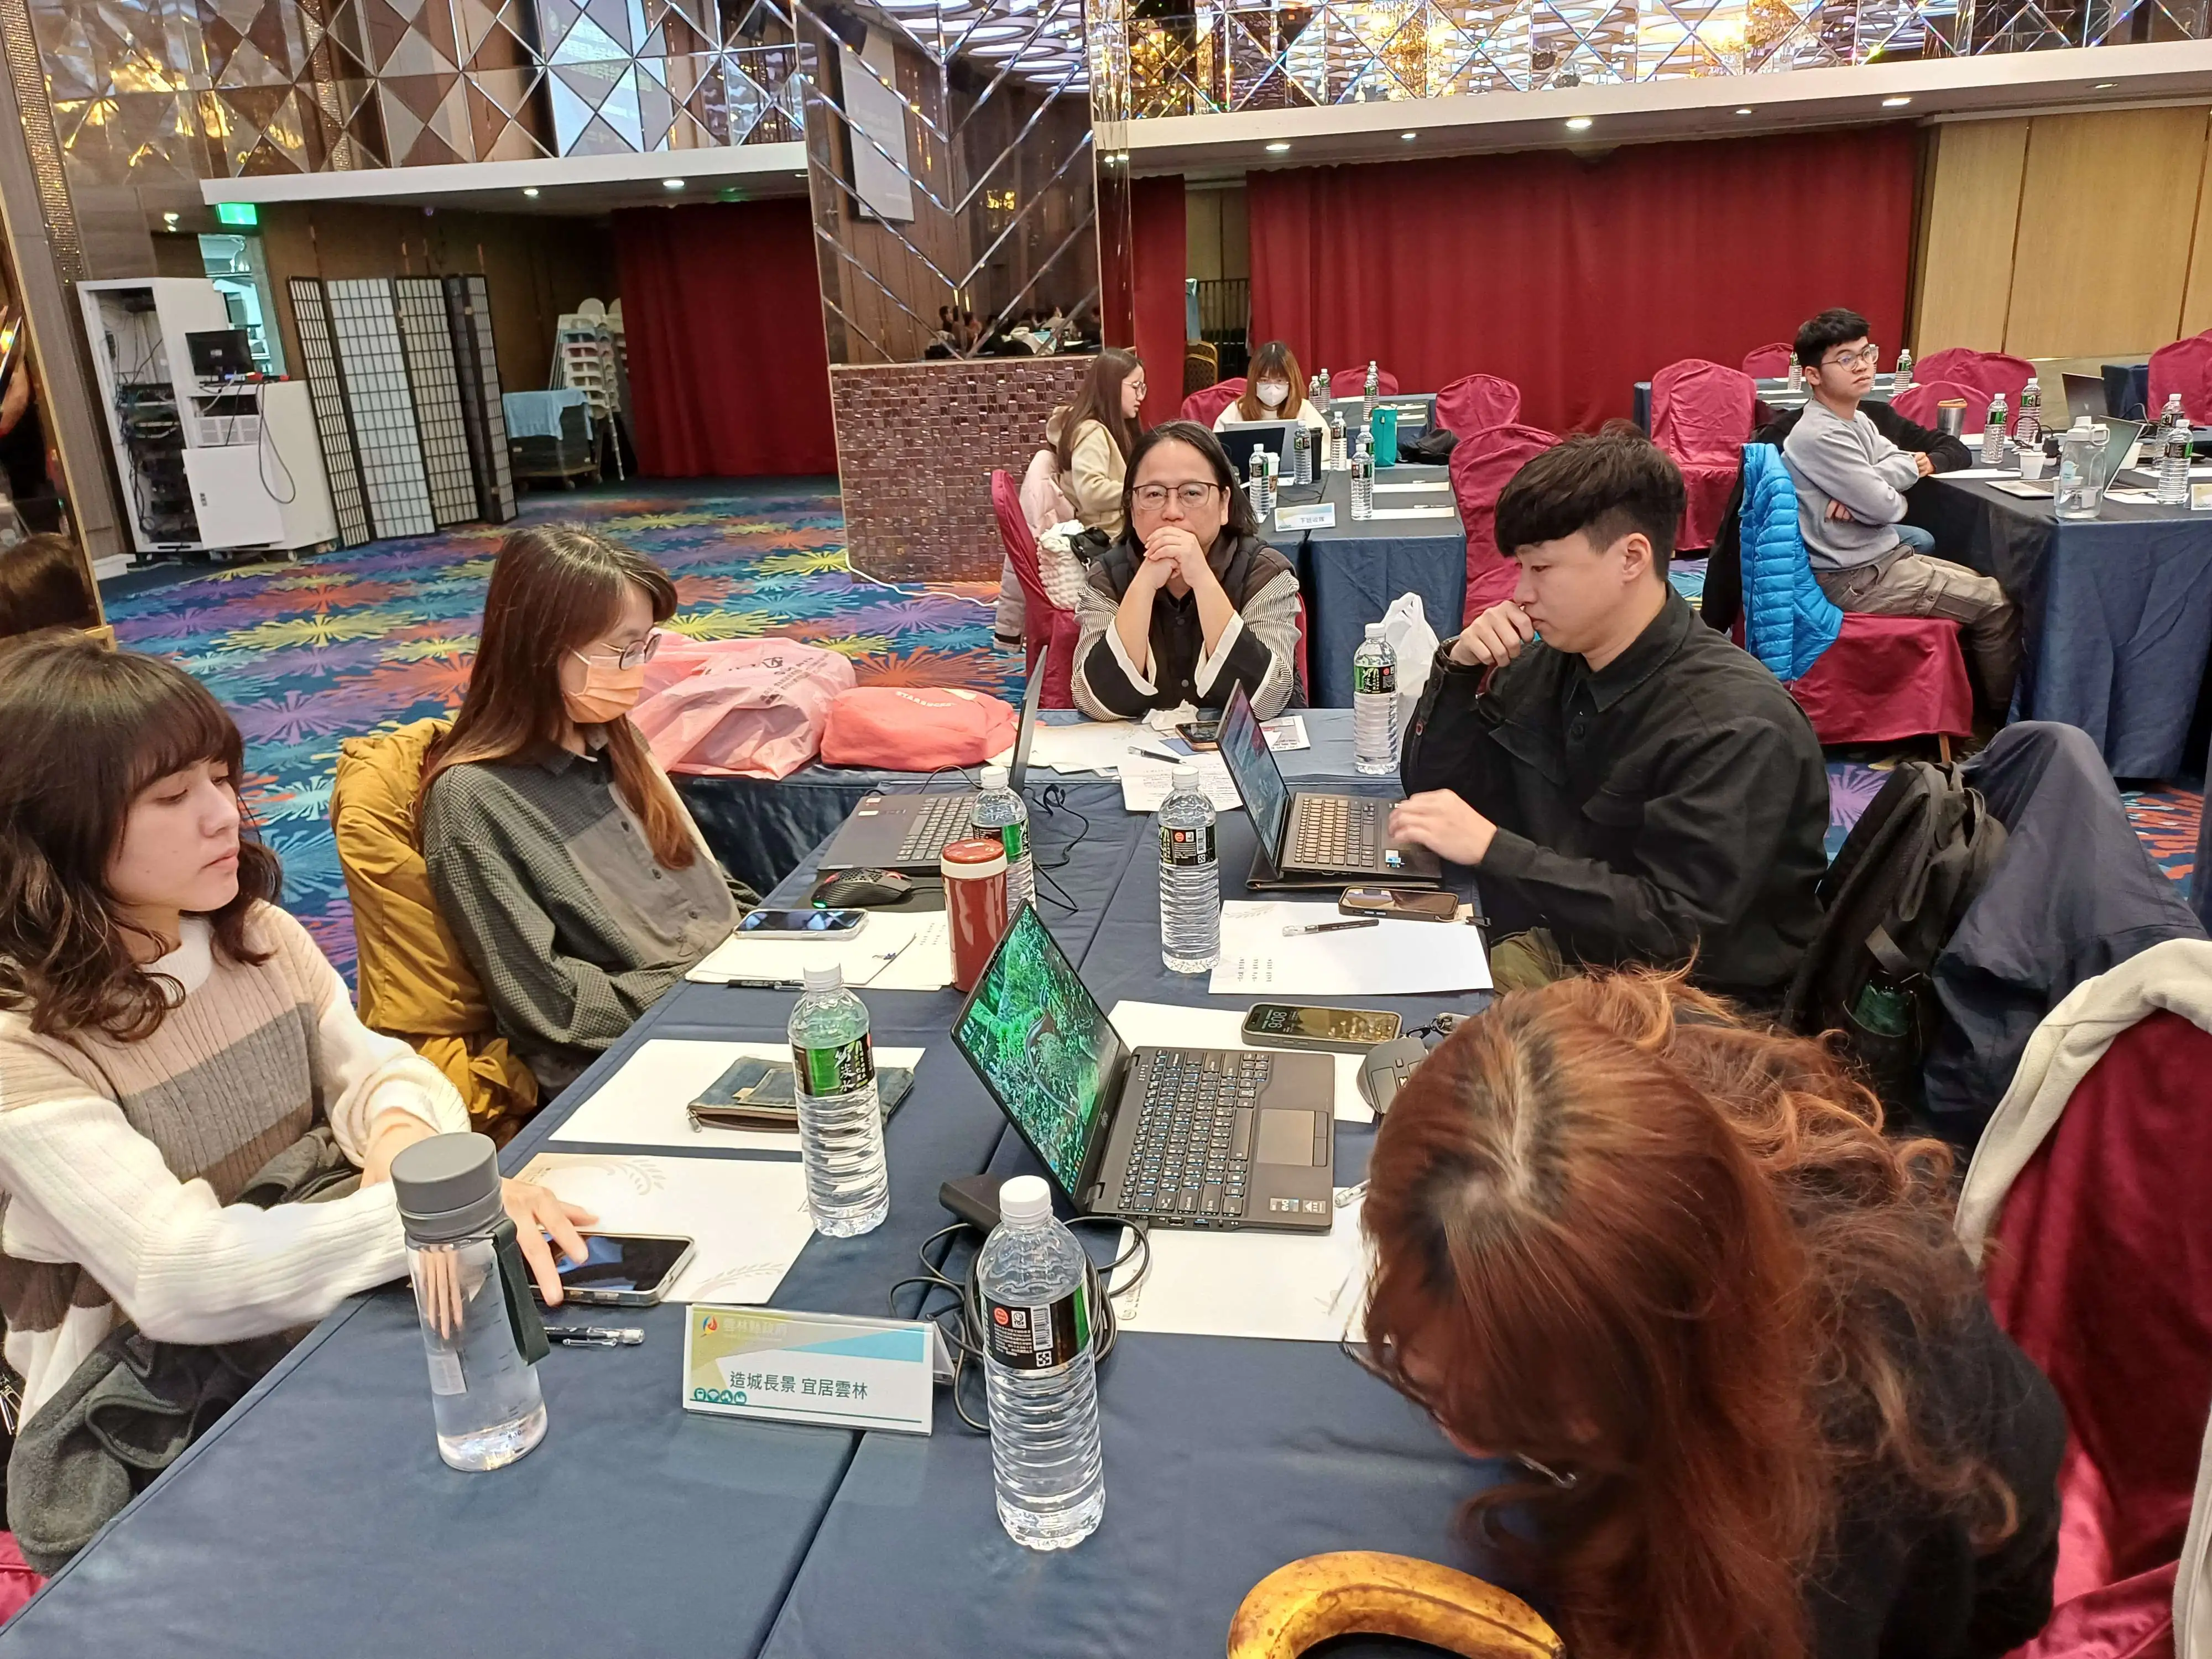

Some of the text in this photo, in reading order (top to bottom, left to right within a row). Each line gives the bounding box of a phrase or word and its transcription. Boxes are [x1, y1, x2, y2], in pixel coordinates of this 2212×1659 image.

[1268, 1011, 1287, 1029] 9:08
[1281, 1199, 1290, 1211] evo
[729, 1370, 868, 1400] 造城長景 宜居雲林
